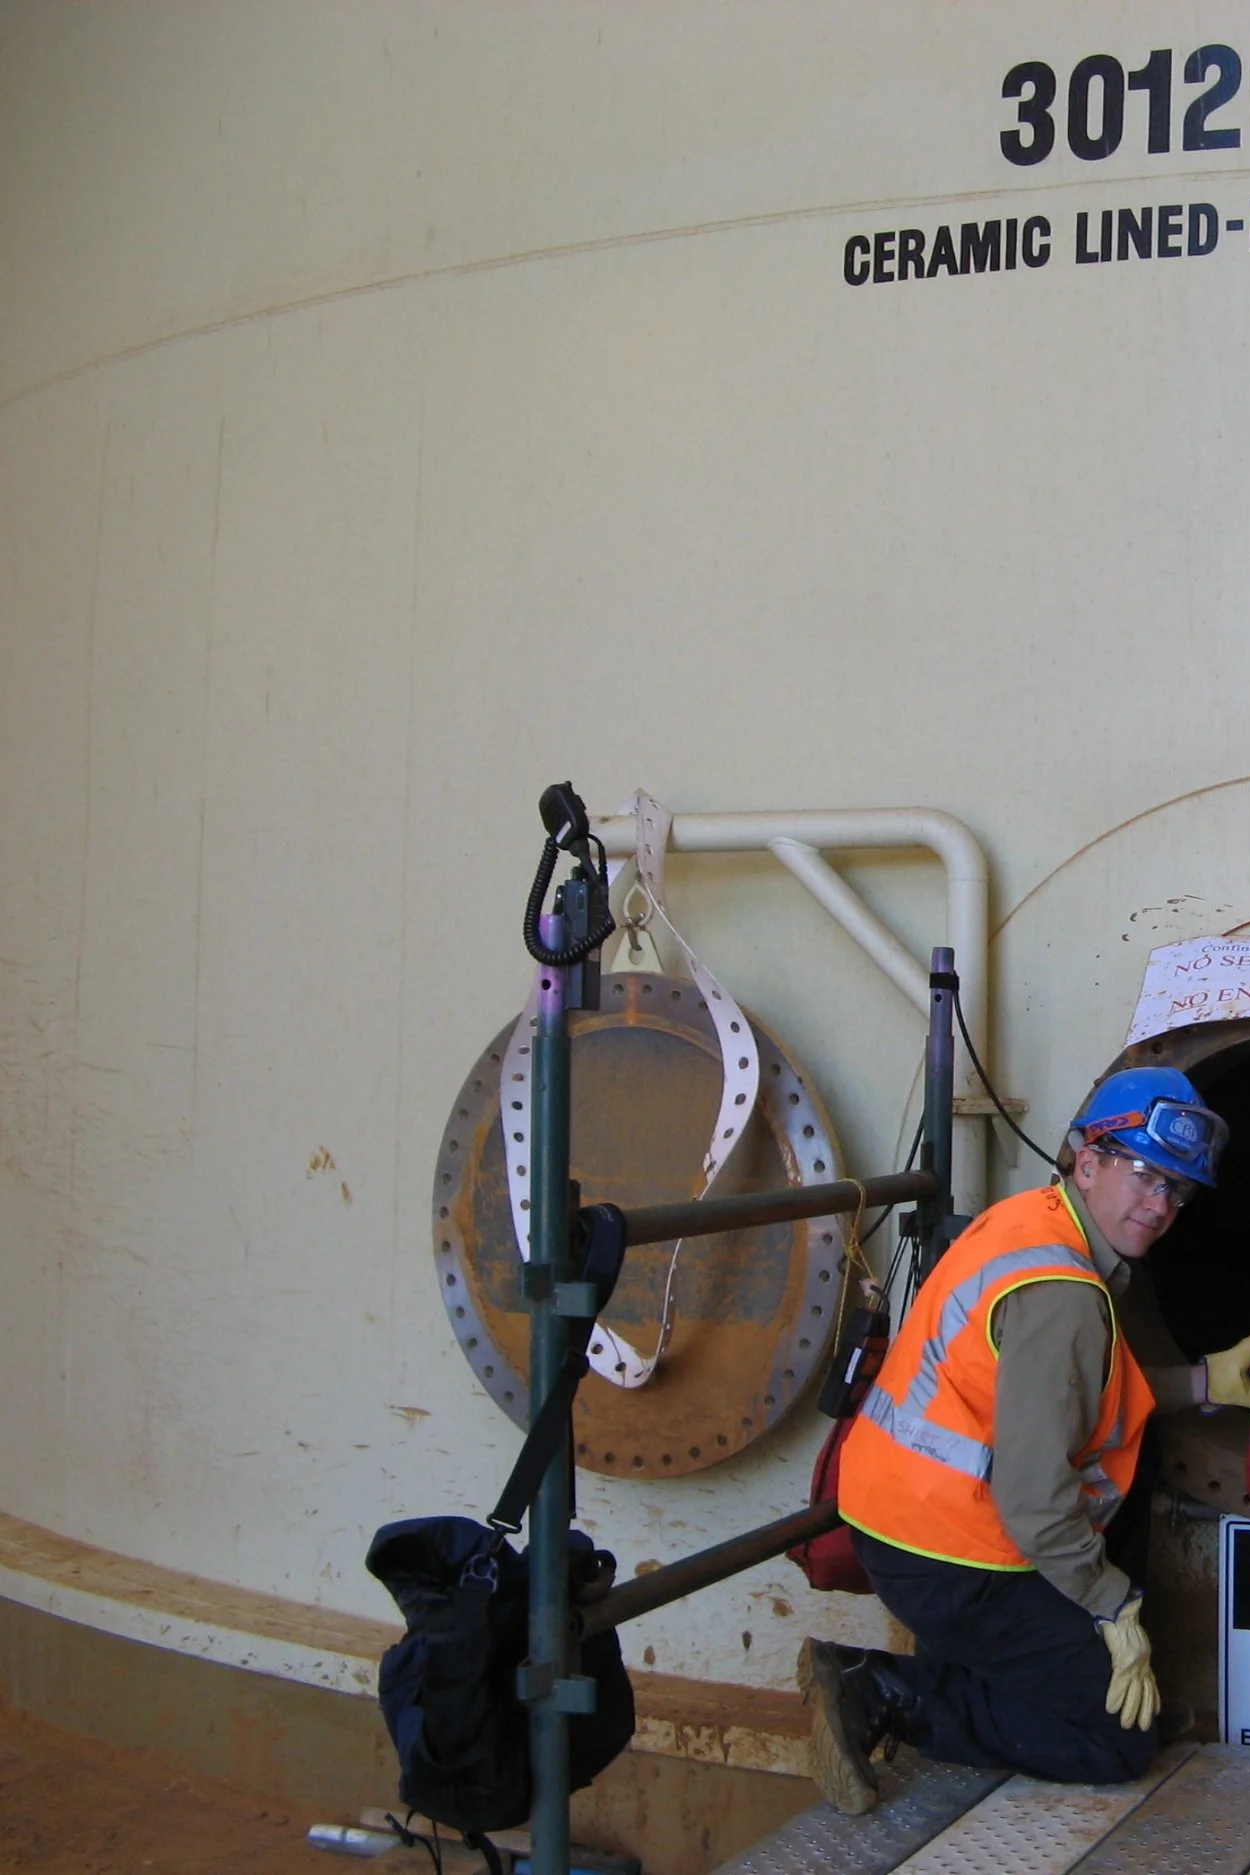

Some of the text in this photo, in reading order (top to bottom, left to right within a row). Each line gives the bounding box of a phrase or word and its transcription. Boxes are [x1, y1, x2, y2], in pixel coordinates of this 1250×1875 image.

[843, 217, 1051, 287] CERAMIC
[1175, 956, 1212, 976] NO
[1170, 992, 1209, 1011] NO
